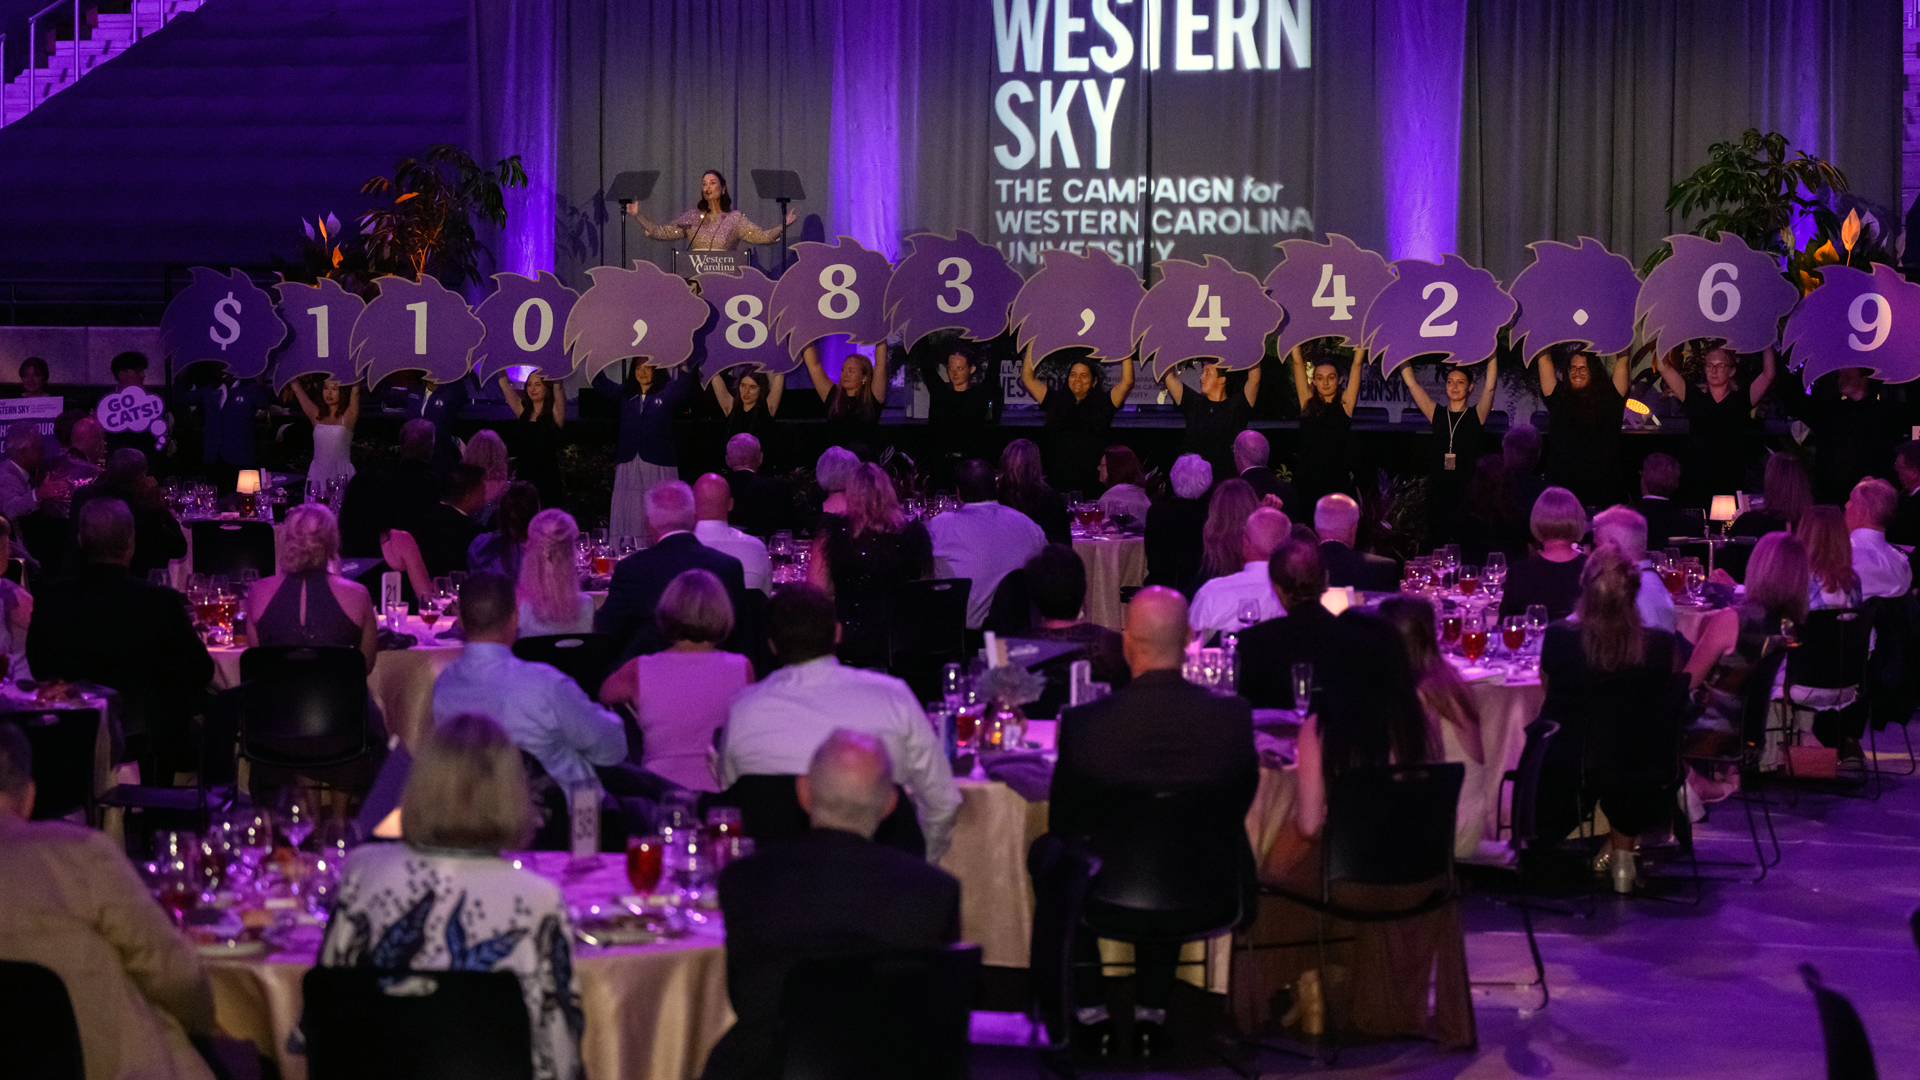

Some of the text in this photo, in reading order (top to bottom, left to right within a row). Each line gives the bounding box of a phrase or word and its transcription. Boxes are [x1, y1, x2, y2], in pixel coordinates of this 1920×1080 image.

[994, 78, 1126, 170] SKY
[995, 176, 1284, 203] THE CAMPAIGN for
[995, 207, 1314, 234] WESTERN CAROLINA
[688, 254, 734, 268] Western
[696, 262, 735, 274] Carolina
[210, 291, 242, 351] $
[307, 304, 330, 358] 1
[406, 300, 428, 355] 1
[512, 297, 554, 352] 0
[723, 294, 769, 350] 8
[817, 263, 860, 320] 8
[936, 256, 975, 314] 3
[1187, 284, 1231, 342] 4
[1311, 263, 1356, 321] 4
[1419, 281, 1459, 338] 2
[1698, 262, 1741, 322] 6
[1847, 292, 1892, 352] 9
[18, 404, 30, 414] SKY
[106, 400, 160, 428] CATS!
[107, 394, 135, 412] GO
[386, 584, 397, 603] 21
